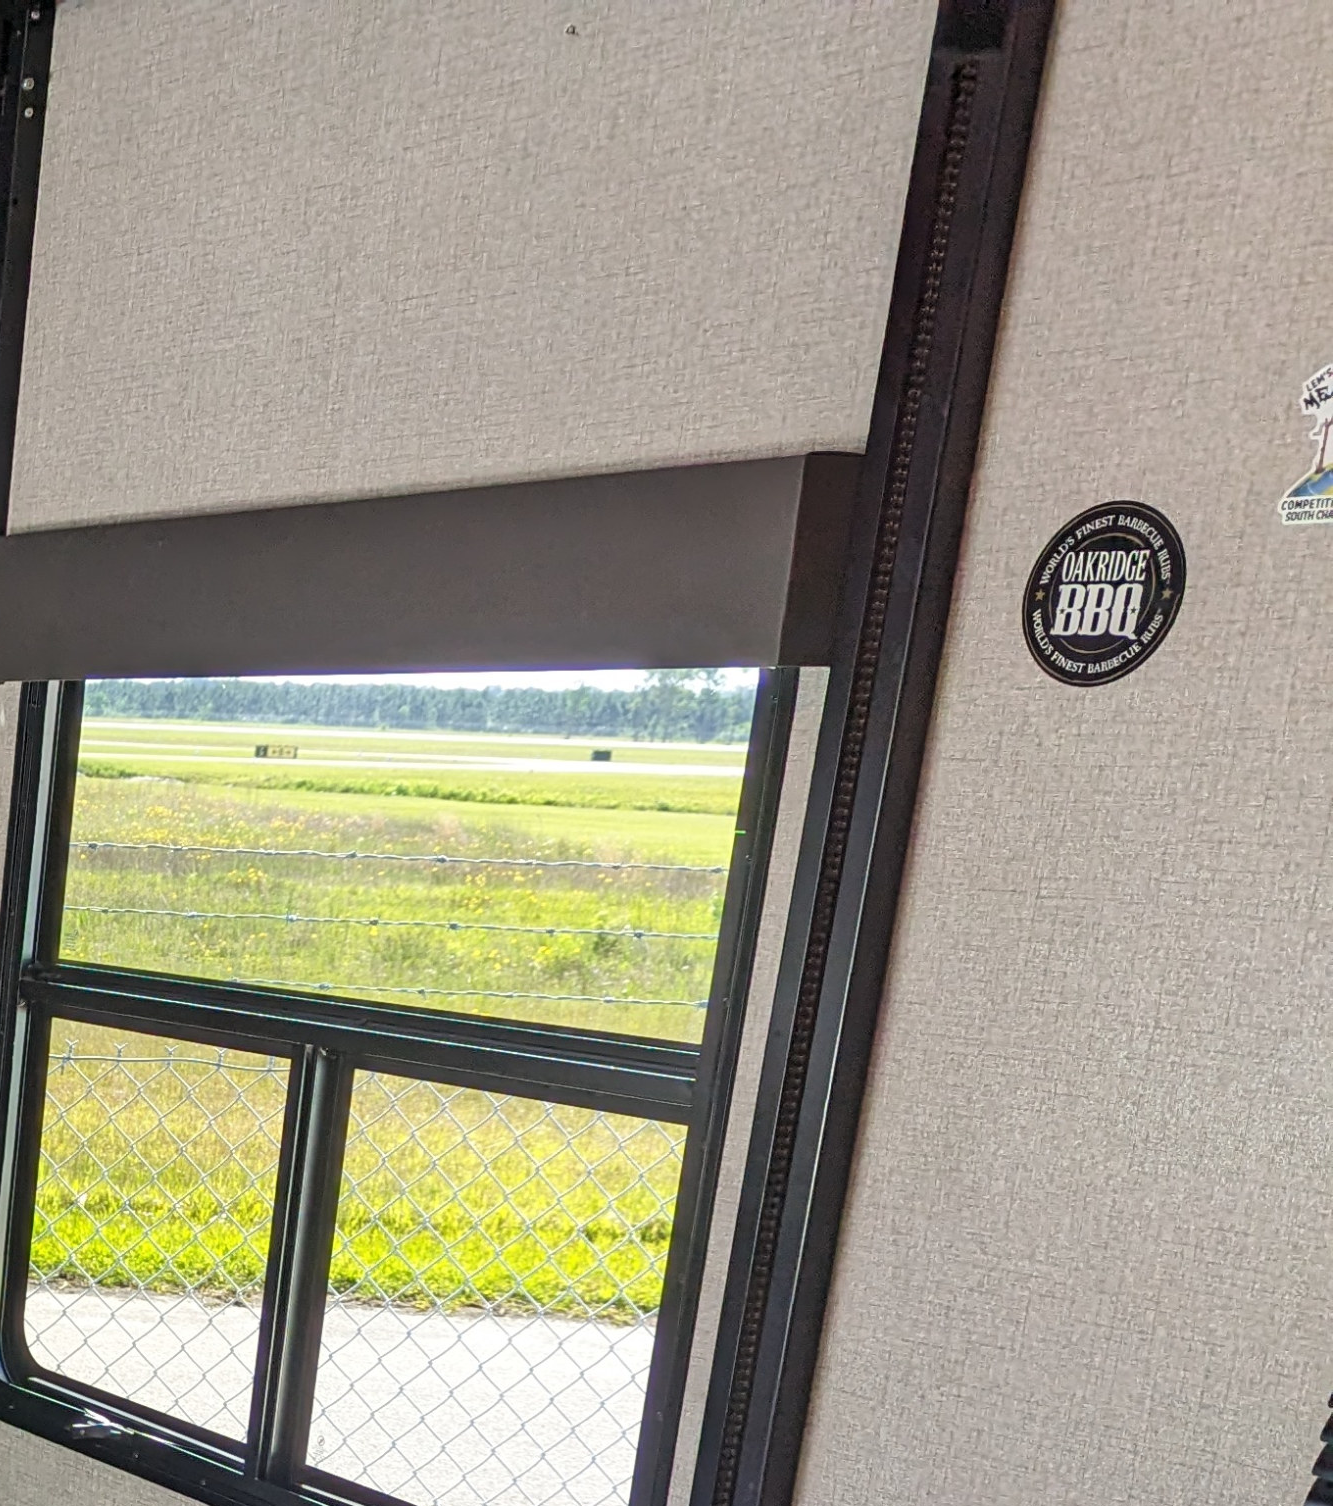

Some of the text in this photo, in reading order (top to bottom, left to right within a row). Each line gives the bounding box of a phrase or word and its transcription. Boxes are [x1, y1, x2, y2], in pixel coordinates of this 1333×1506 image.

[1285, 510, 1315, 522] SOUTH
[1039, 514, 1172, 585] WORLD'S FINEST BARBECUE RUBS
[1061, 549, 1151, 582] OAKRIDGE
[1050, 582, 1144, 640] BBQ
[1032, 608, 1164, 674] WORLD'S FINEST BARBECUE RUBS
